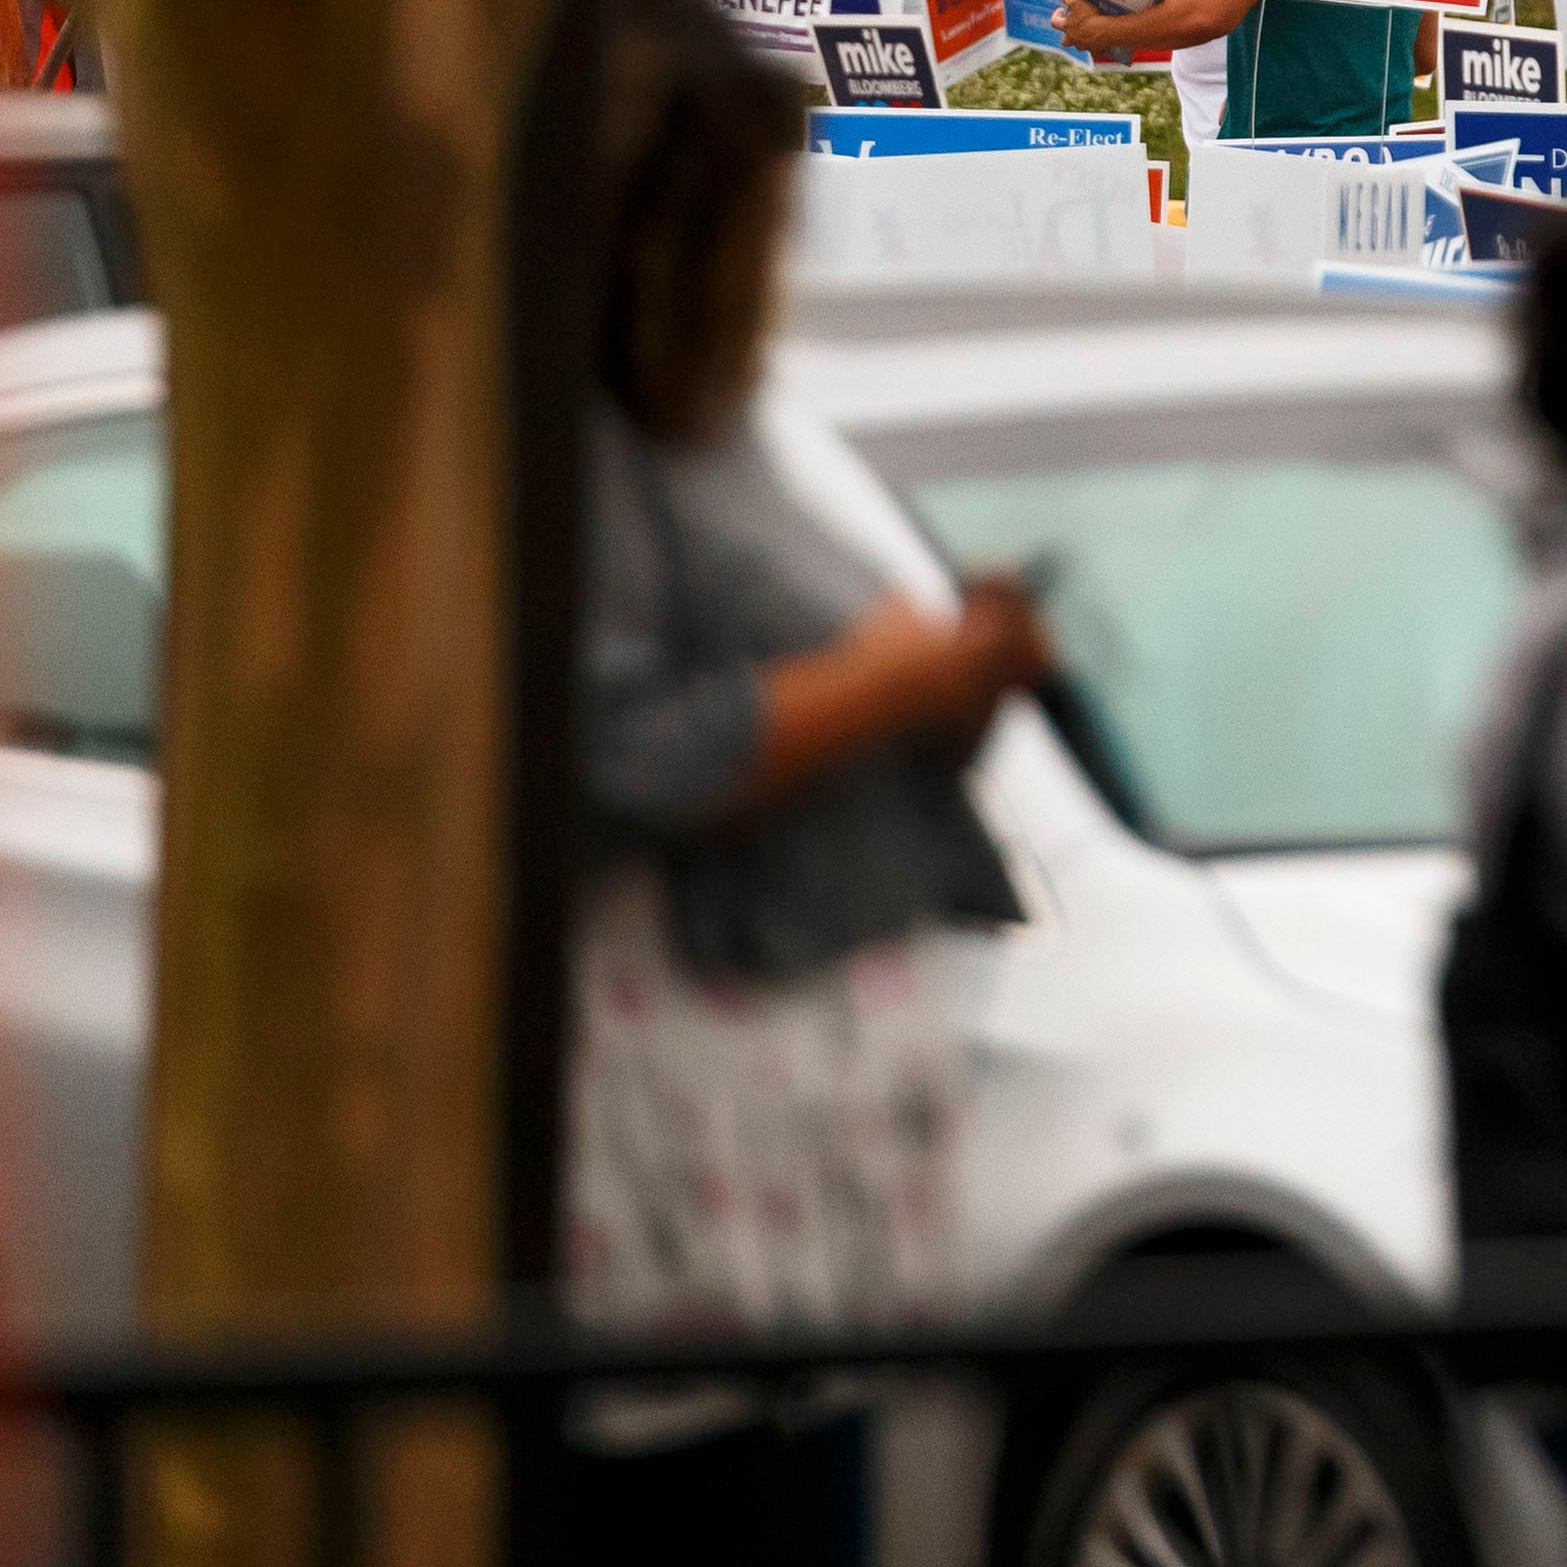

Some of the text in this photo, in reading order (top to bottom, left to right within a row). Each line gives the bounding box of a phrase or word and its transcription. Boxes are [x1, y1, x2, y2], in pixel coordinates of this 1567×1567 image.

[835, 28, 917, 77] mike
[1461, 38, 1543, 94] mike
[1028, 126, 1125, 147] Re-Elect
